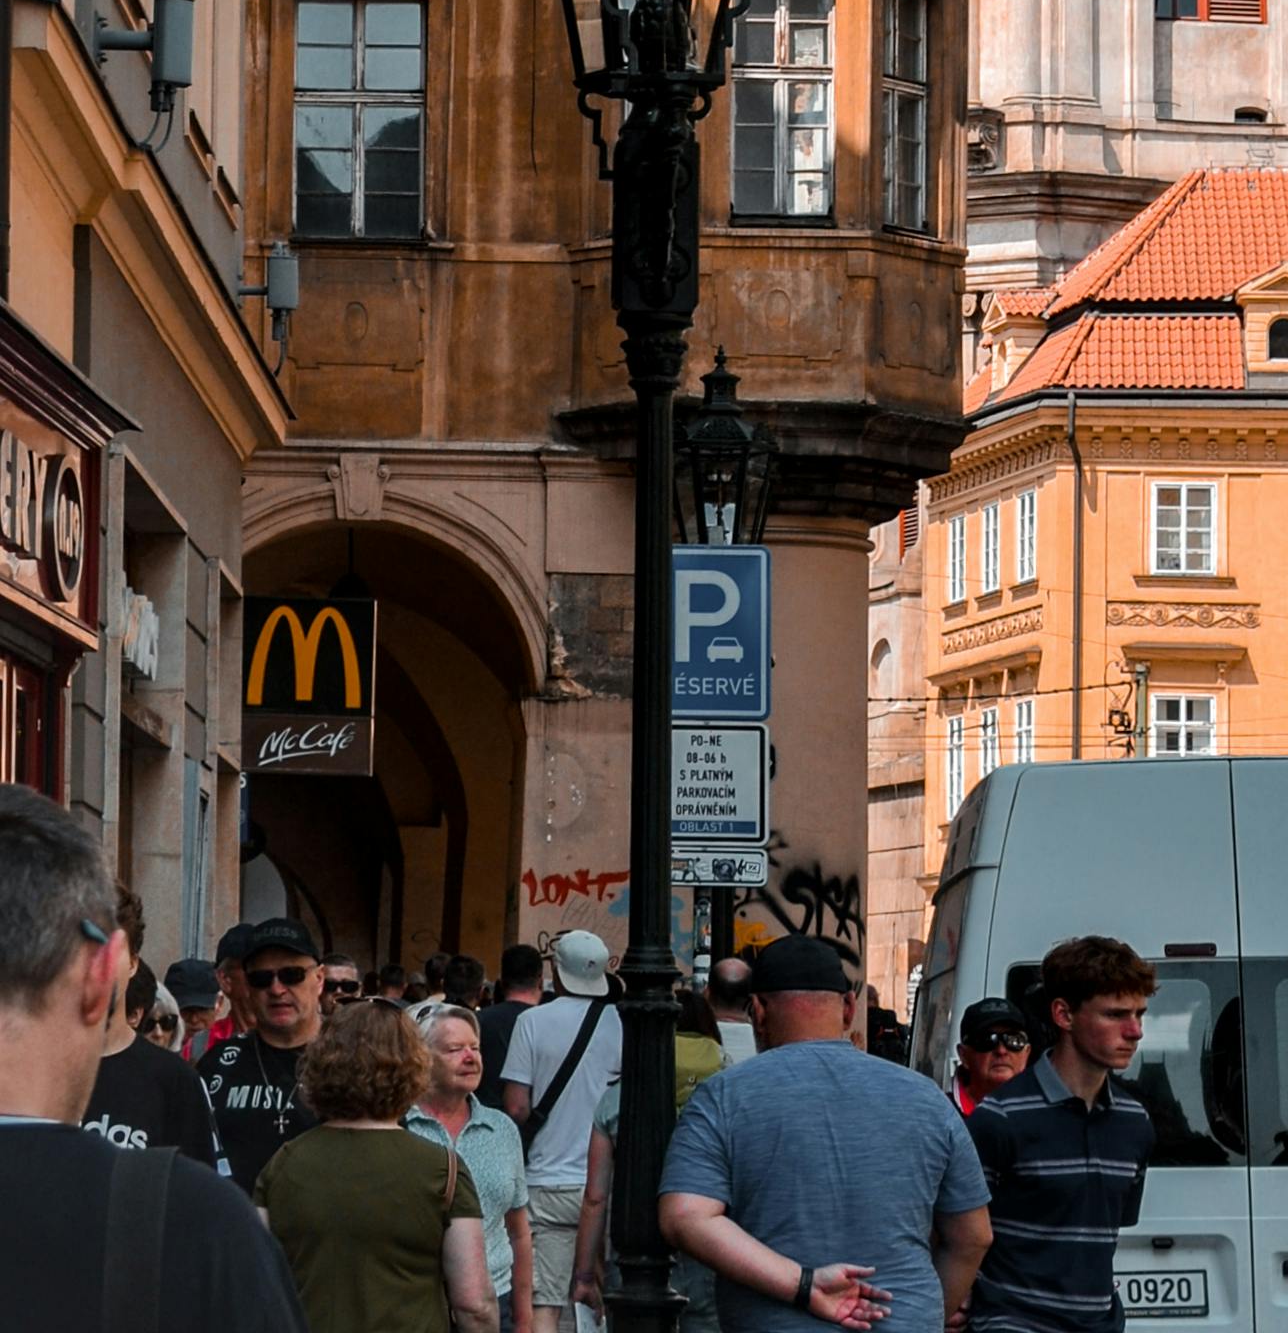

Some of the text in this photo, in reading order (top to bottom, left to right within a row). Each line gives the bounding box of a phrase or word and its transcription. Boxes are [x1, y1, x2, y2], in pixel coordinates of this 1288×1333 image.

[674, 672, 755, 696] ÉSERVÉ
[259, 722, 356, 763] McCafé
[691, 735, 722, 747] PO-NE
[686, 752, 727, 764] 08-06 h
[680, 768, 734, 781] S PLATNÝM
[677, 786, 736, 799] PARKOVACÍM
[675, 802, 737, 816] OPRÁVNĚNÍM
[679, 821, 734, 832] OBLAST 1
[1127, 1277, 1192, 1304] 0920
